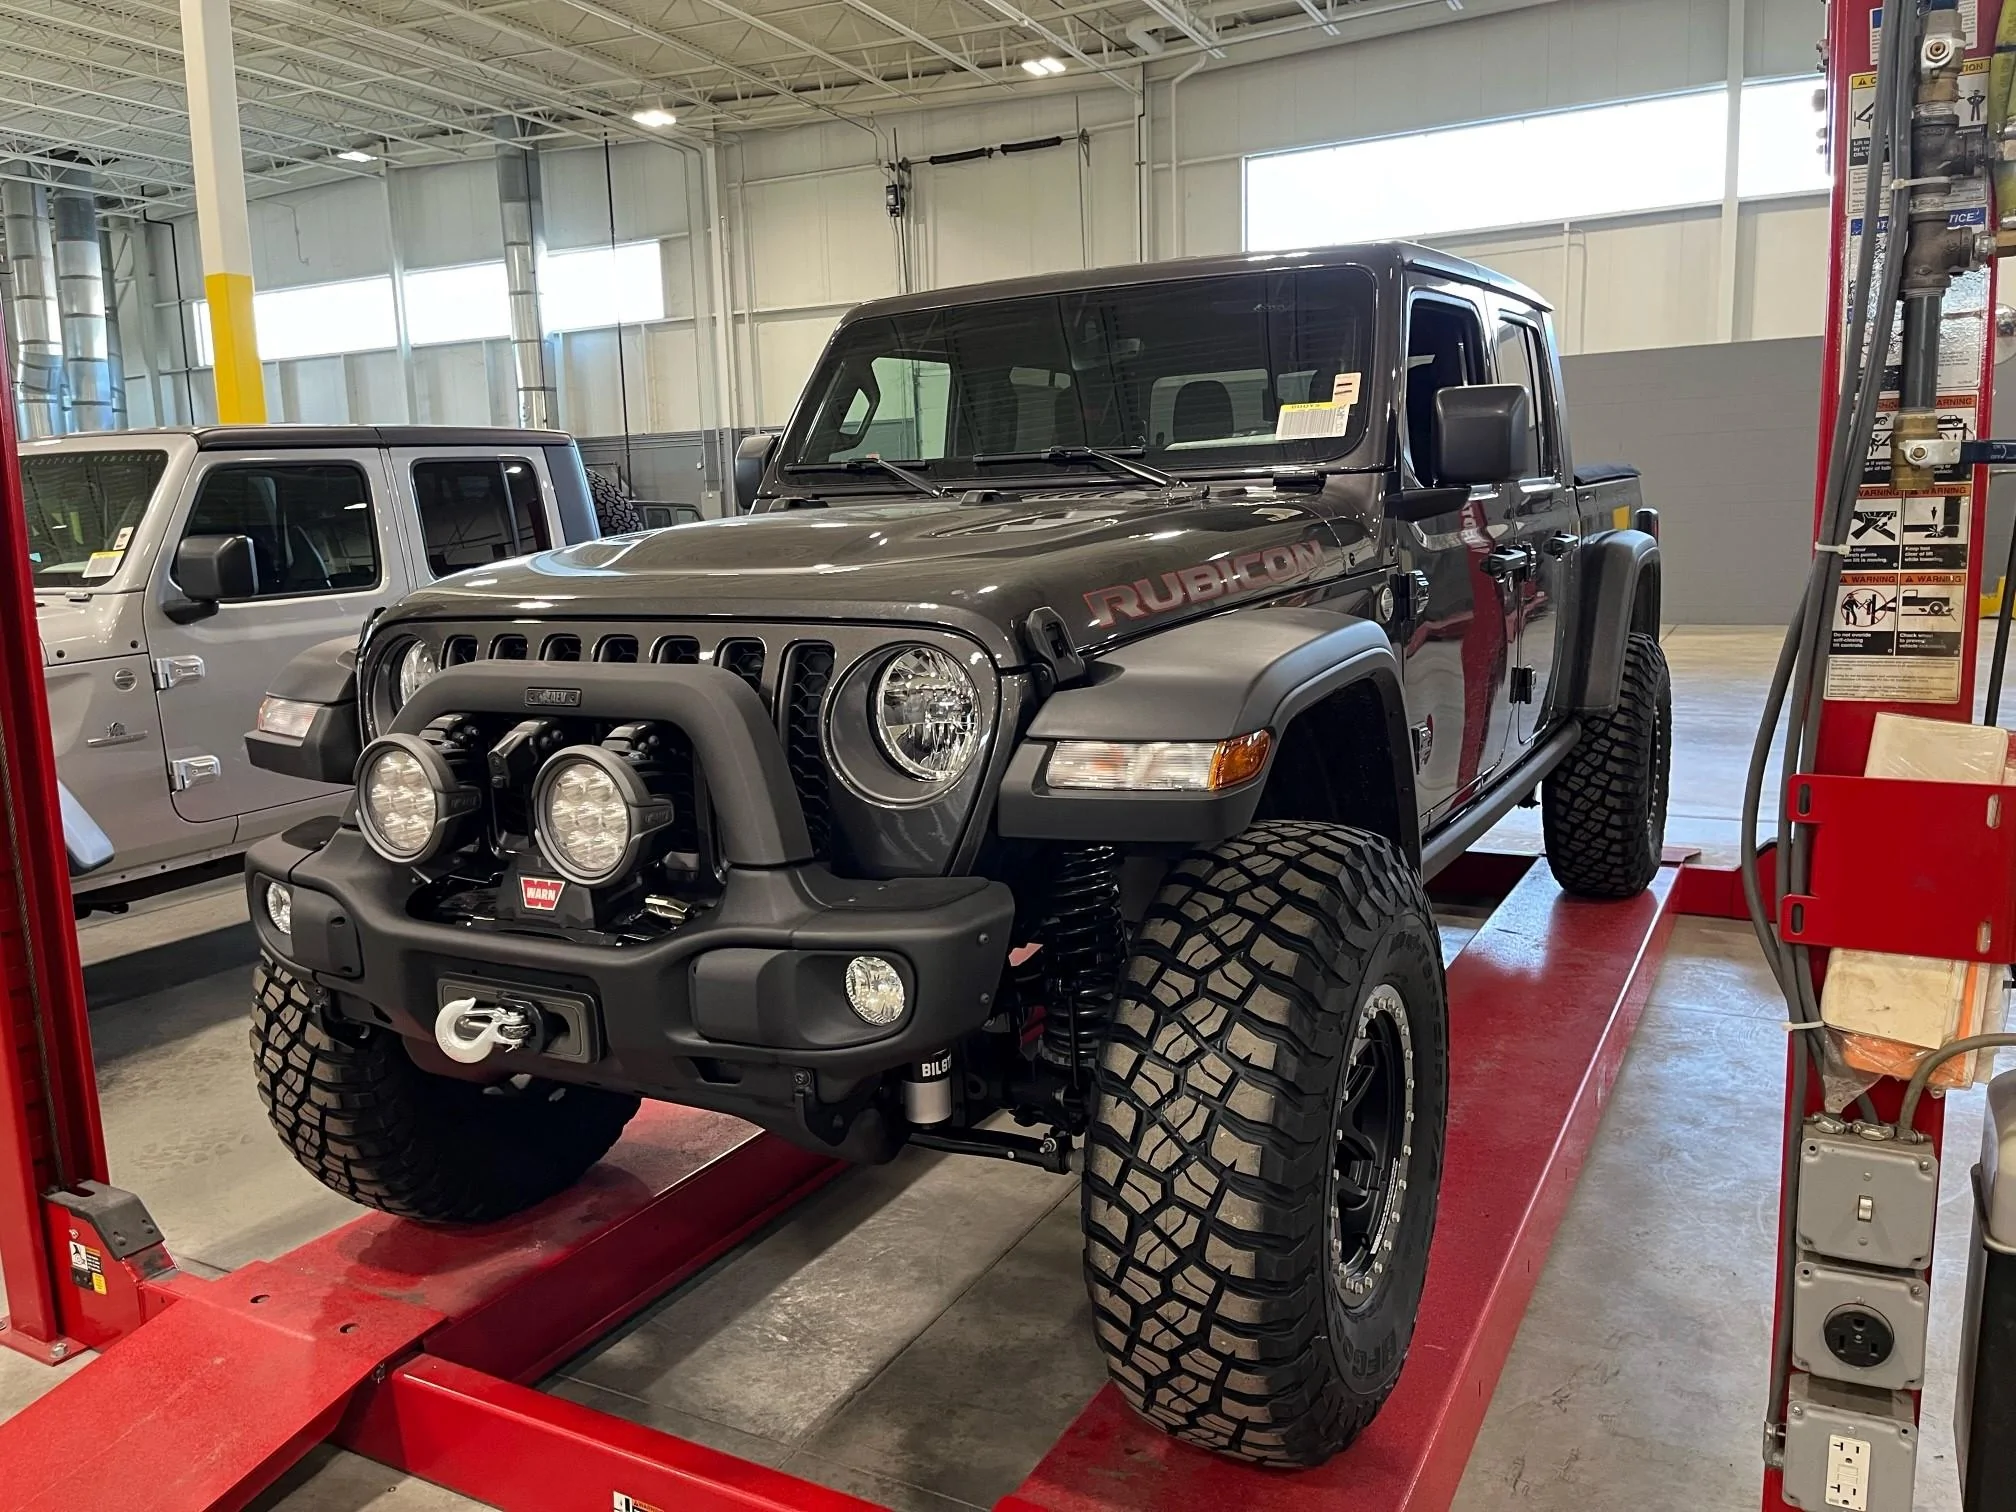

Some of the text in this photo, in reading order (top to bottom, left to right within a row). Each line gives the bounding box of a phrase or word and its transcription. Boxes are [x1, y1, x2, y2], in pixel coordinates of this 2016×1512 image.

[1936, 397, 1972, 406] ARNING
[1851, 575, 1895, 583] WARNING
[1917, 575, 1962, 583] WARNING
[1083, 540, 1325, 629] RUBICON
[526, 887, 556, 901] WARN
